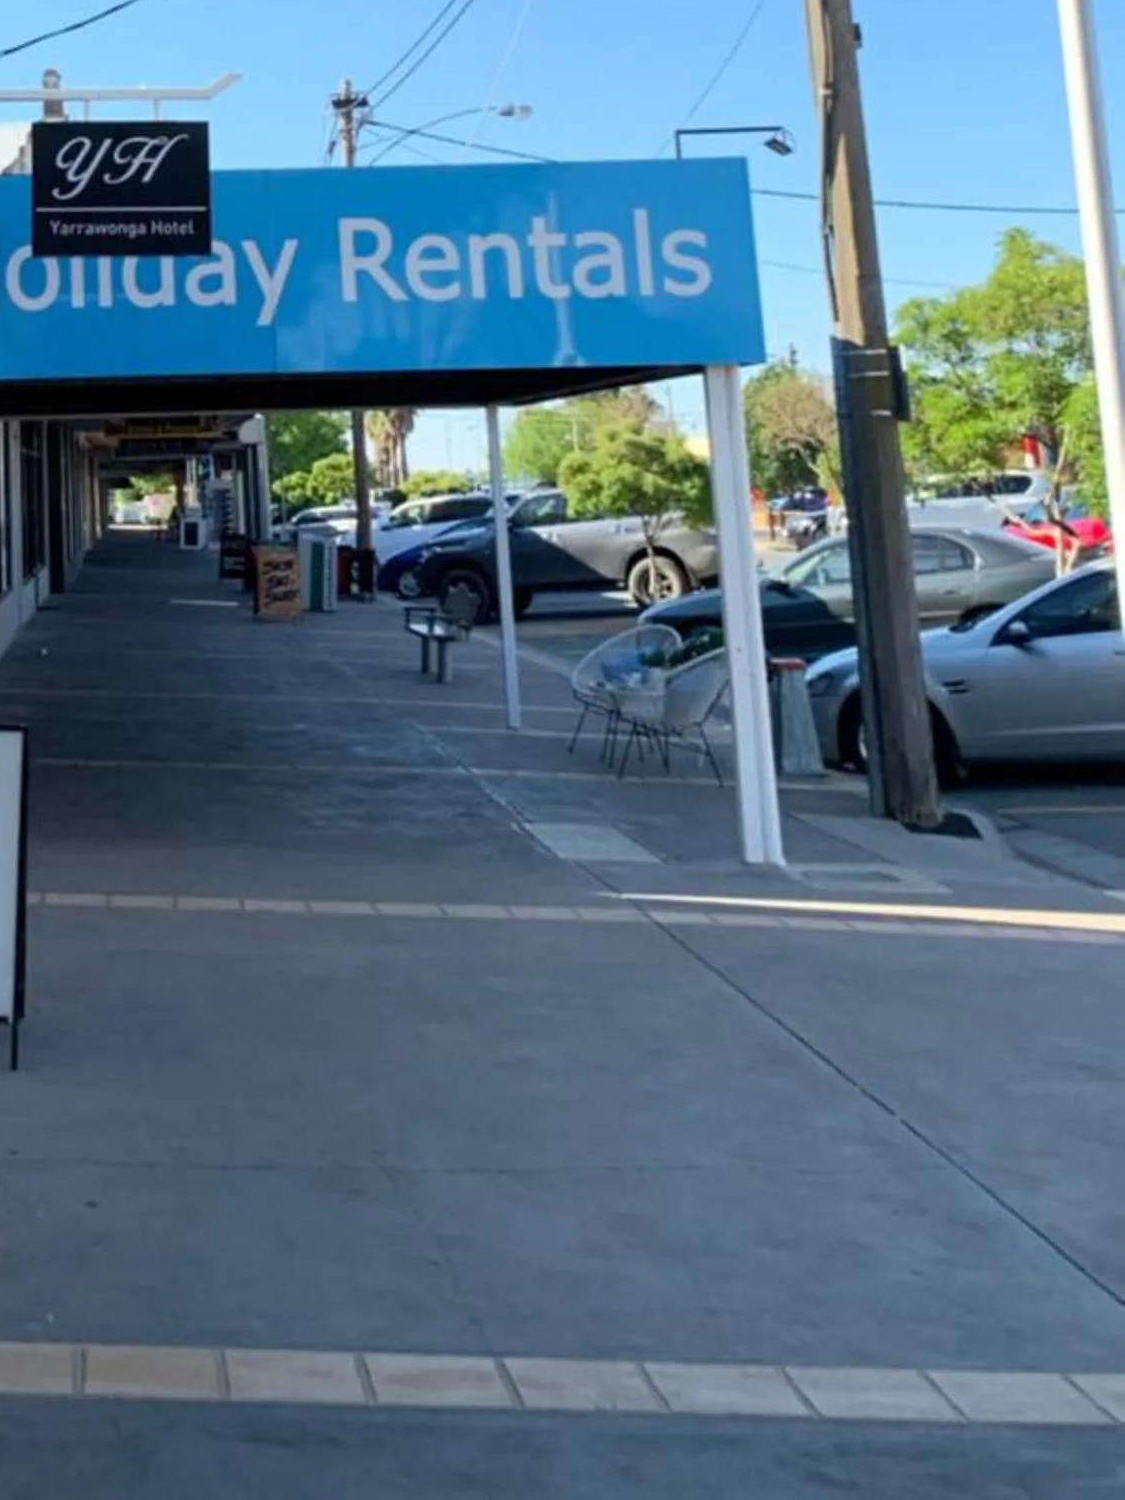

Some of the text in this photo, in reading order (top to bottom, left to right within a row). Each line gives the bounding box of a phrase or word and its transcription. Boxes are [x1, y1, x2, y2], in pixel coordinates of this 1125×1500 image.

[50, 219, 195, 239] Yarrawonga Hotel
[337, 208, 713, 303] Rentals
